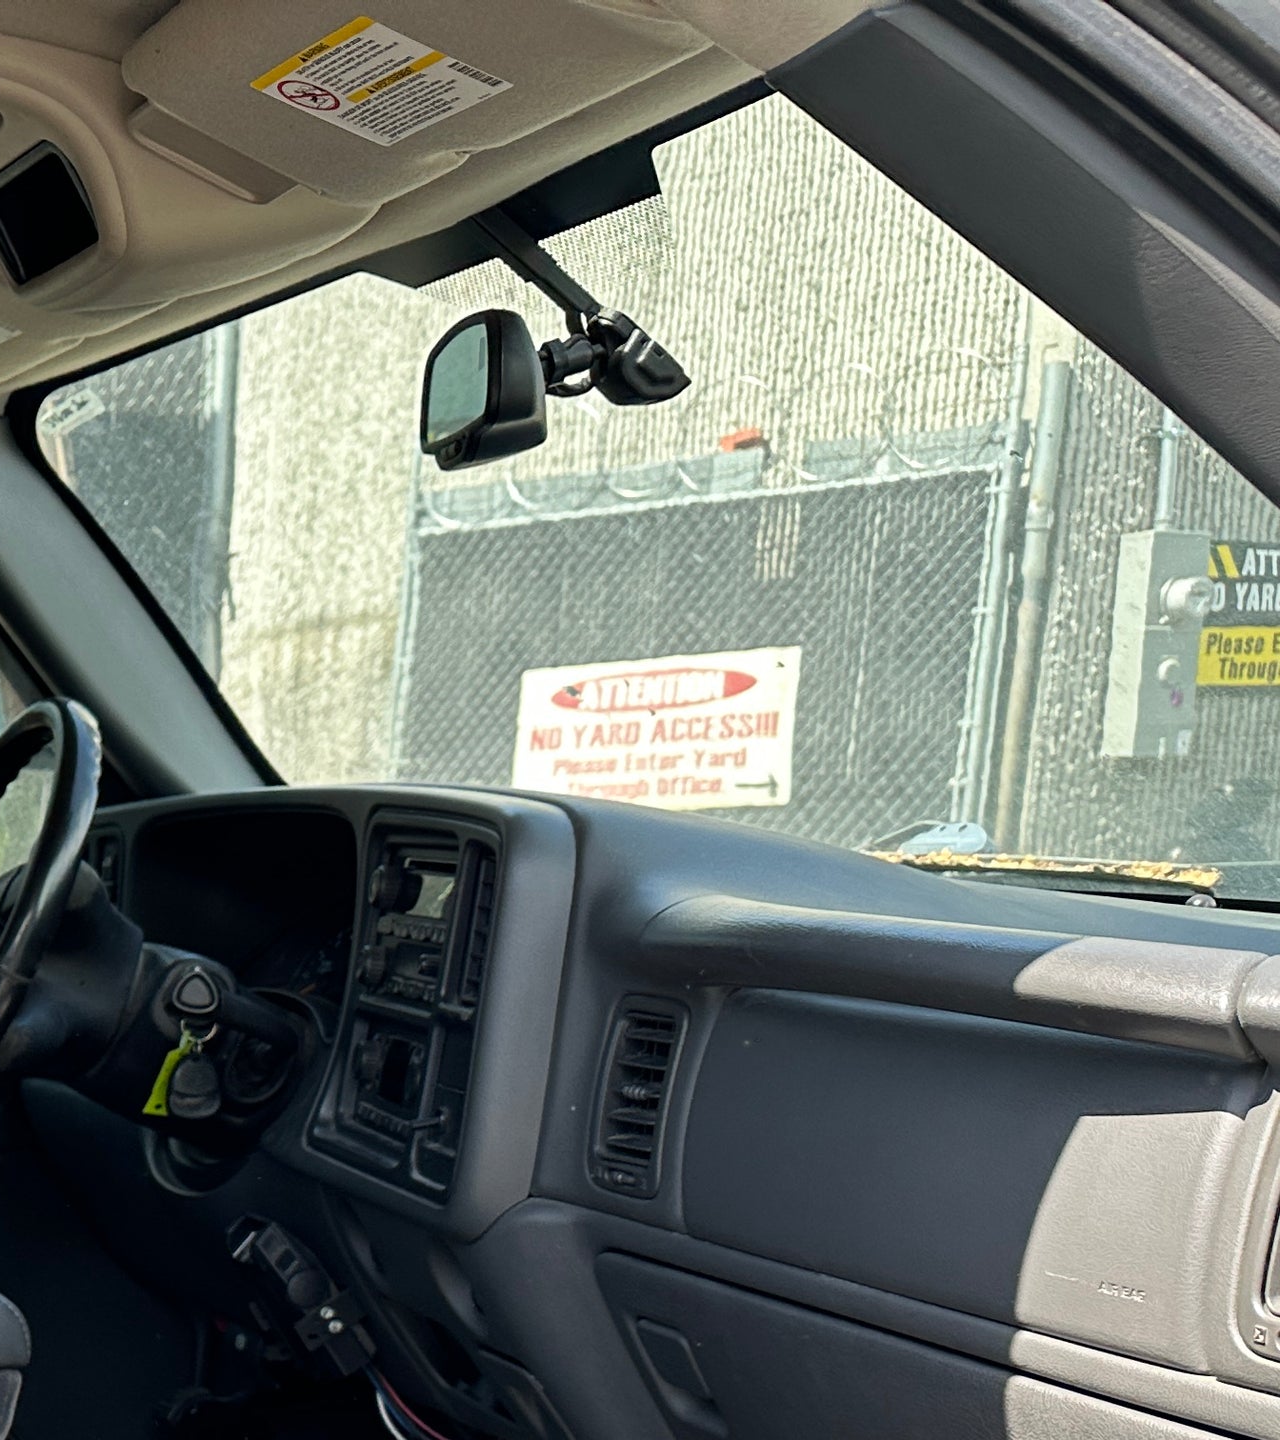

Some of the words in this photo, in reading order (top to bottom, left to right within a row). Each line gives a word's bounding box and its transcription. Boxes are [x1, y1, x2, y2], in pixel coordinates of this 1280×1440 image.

[1206, 632, 1265, 655] Please
[1219, 657, 1280, 685] Throug
[577, 669, 726, 711] ATTENTION
[529, 726, 562, 751] NO
[573, 721, 640, 749] YARD
[650, 711, 780, 745] ACCESS!!!
[694, 748, 748, 769] Yard
[657, 775, 722, 796] Office
